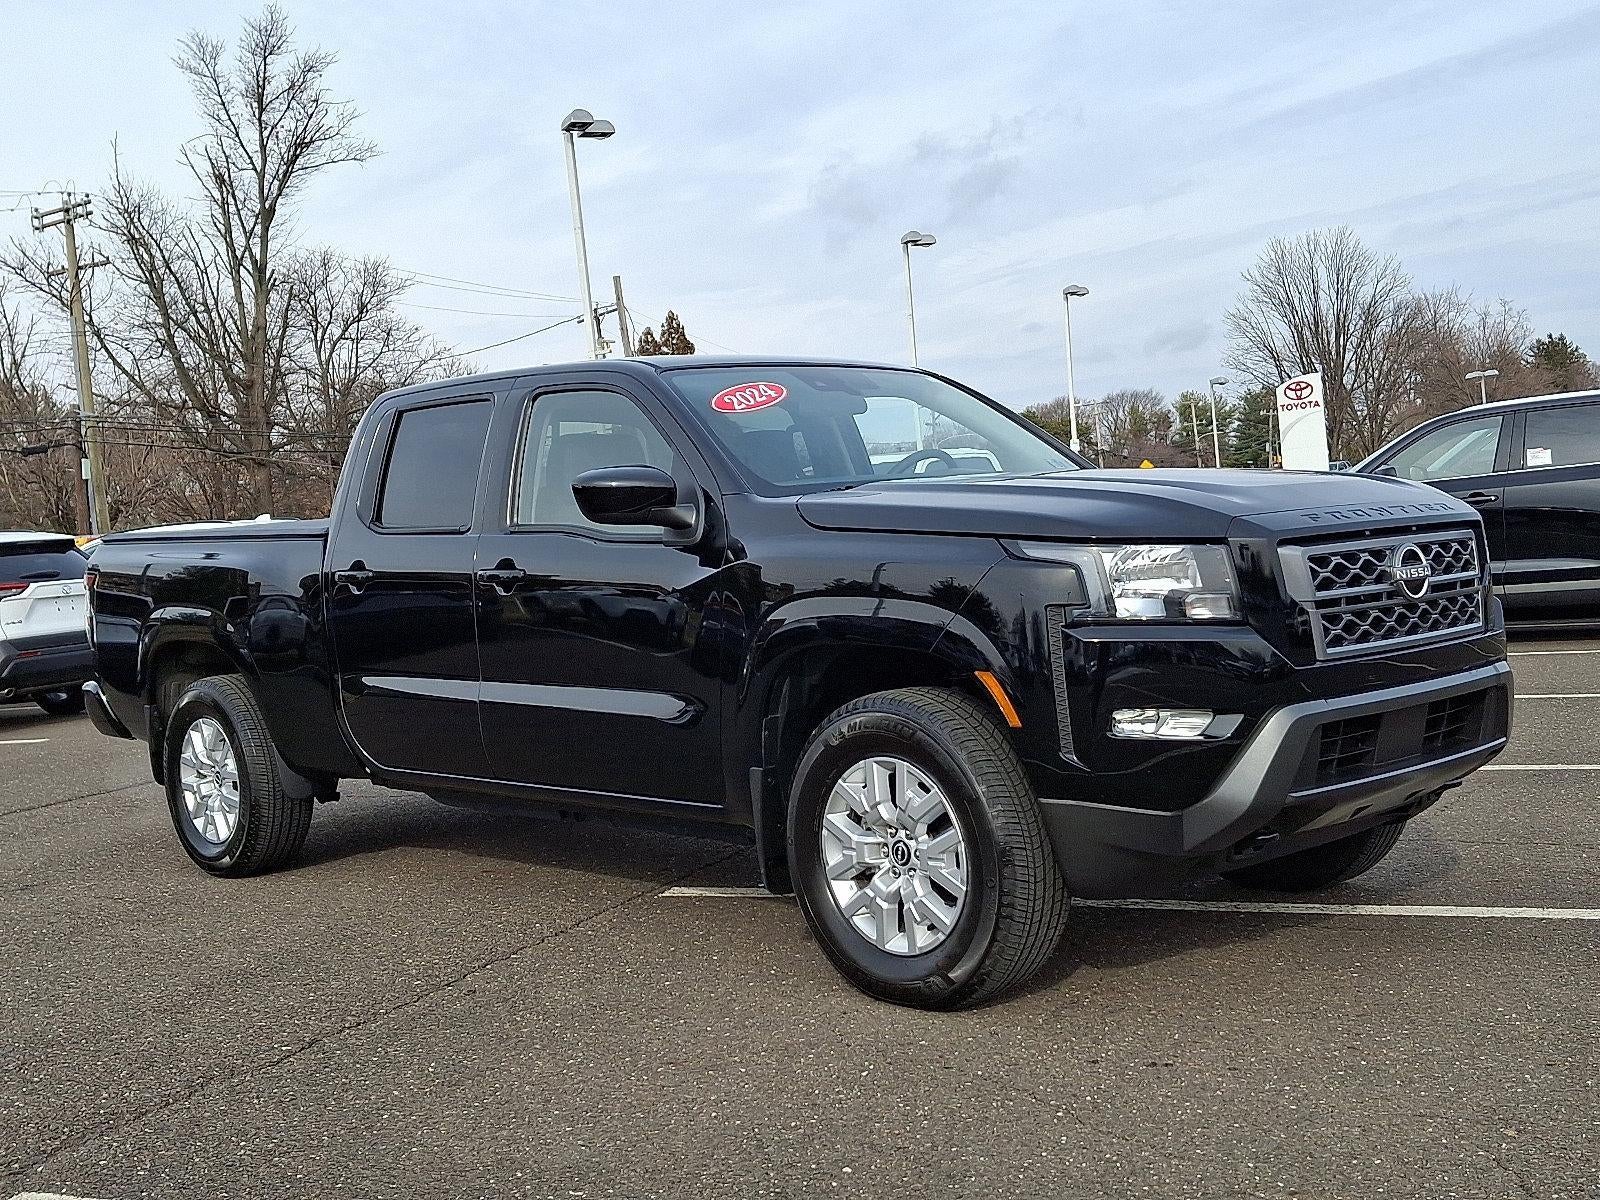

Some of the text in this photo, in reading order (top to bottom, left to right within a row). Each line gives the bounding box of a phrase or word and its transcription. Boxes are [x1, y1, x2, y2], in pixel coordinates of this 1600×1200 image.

[723, 384, 779, 410] 2024
[1280, 400, 1321, 411] TOYOTA
[1300, 502, 1456, 521] FRONTIER
[1396, 566, 1430, 580] NISSA
